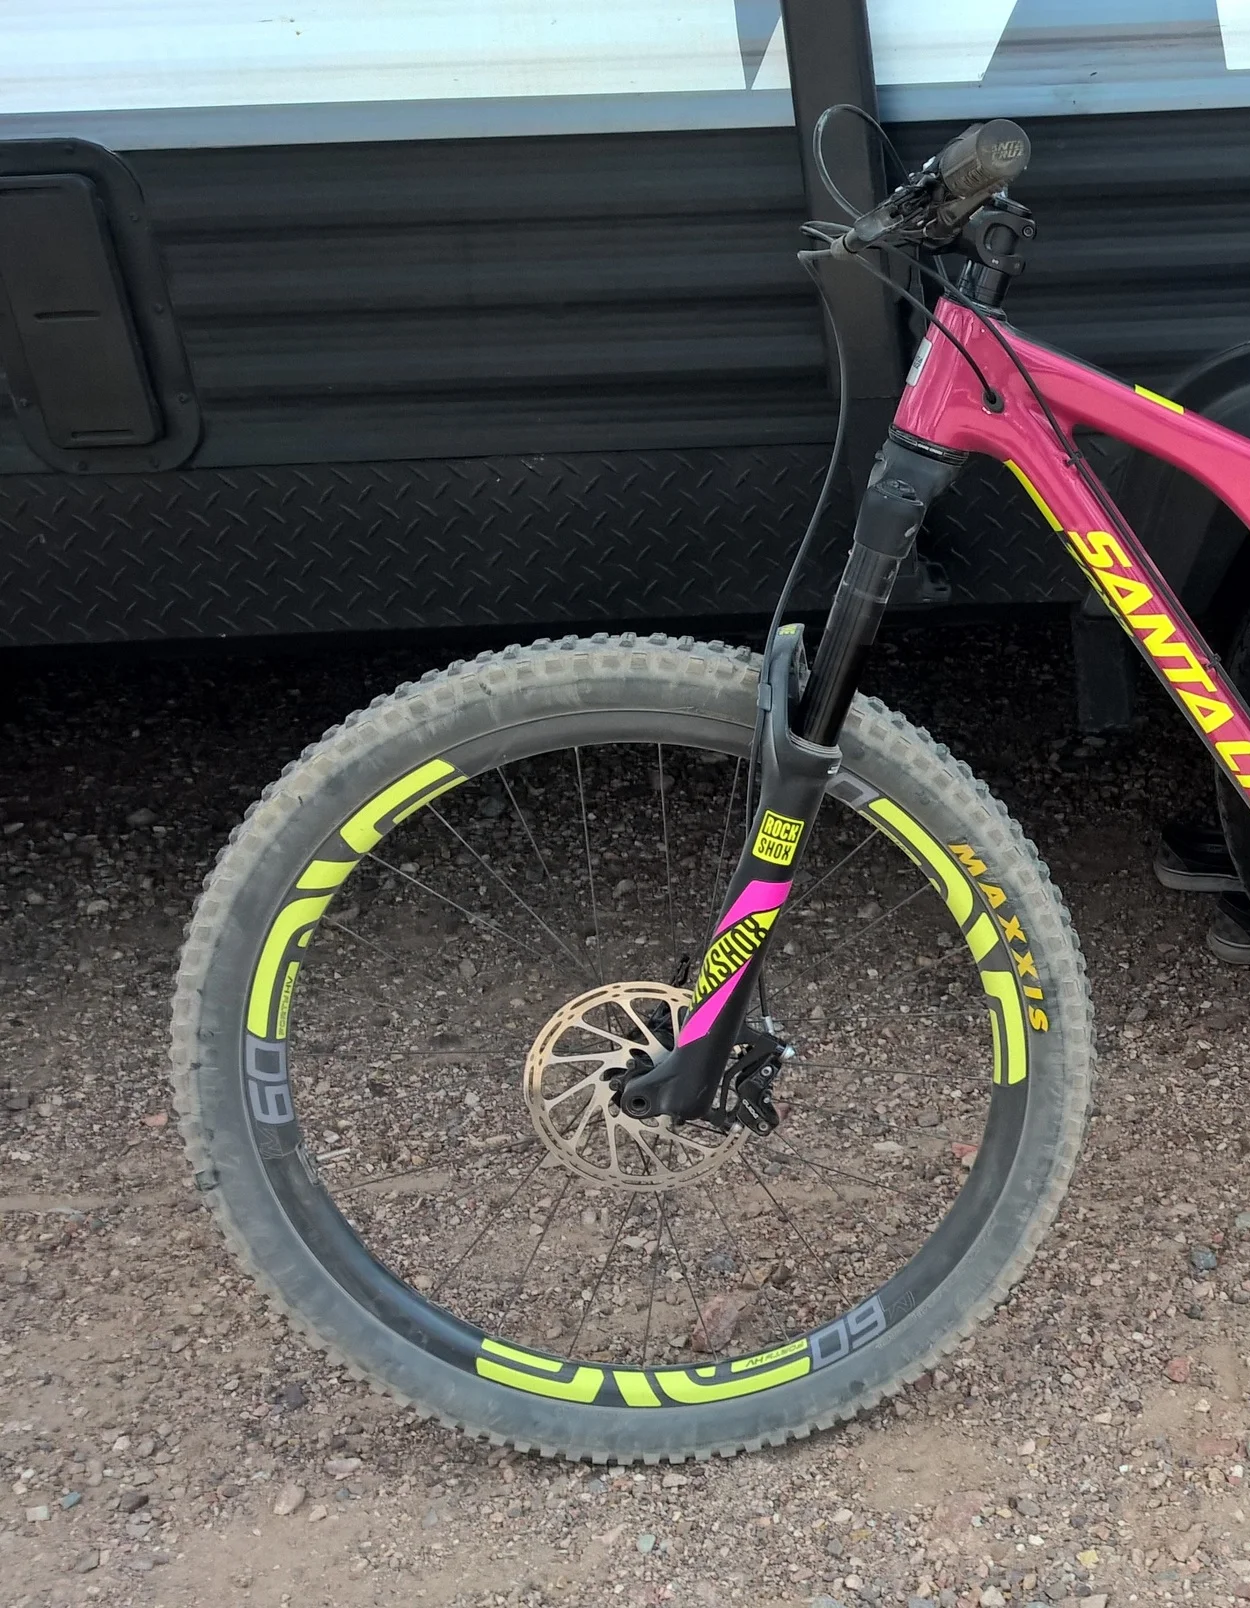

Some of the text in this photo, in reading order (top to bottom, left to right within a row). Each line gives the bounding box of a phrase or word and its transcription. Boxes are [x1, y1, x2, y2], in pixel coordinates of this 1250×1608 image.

[1067, 531, 1234, 734] SANTA
[764, 818, 800, 843] ROCK
[757, 838, 793, 861] SHOX
[947, 843, 1049, 1033] MAXXIS
[283, 974, 294, 997] HV
